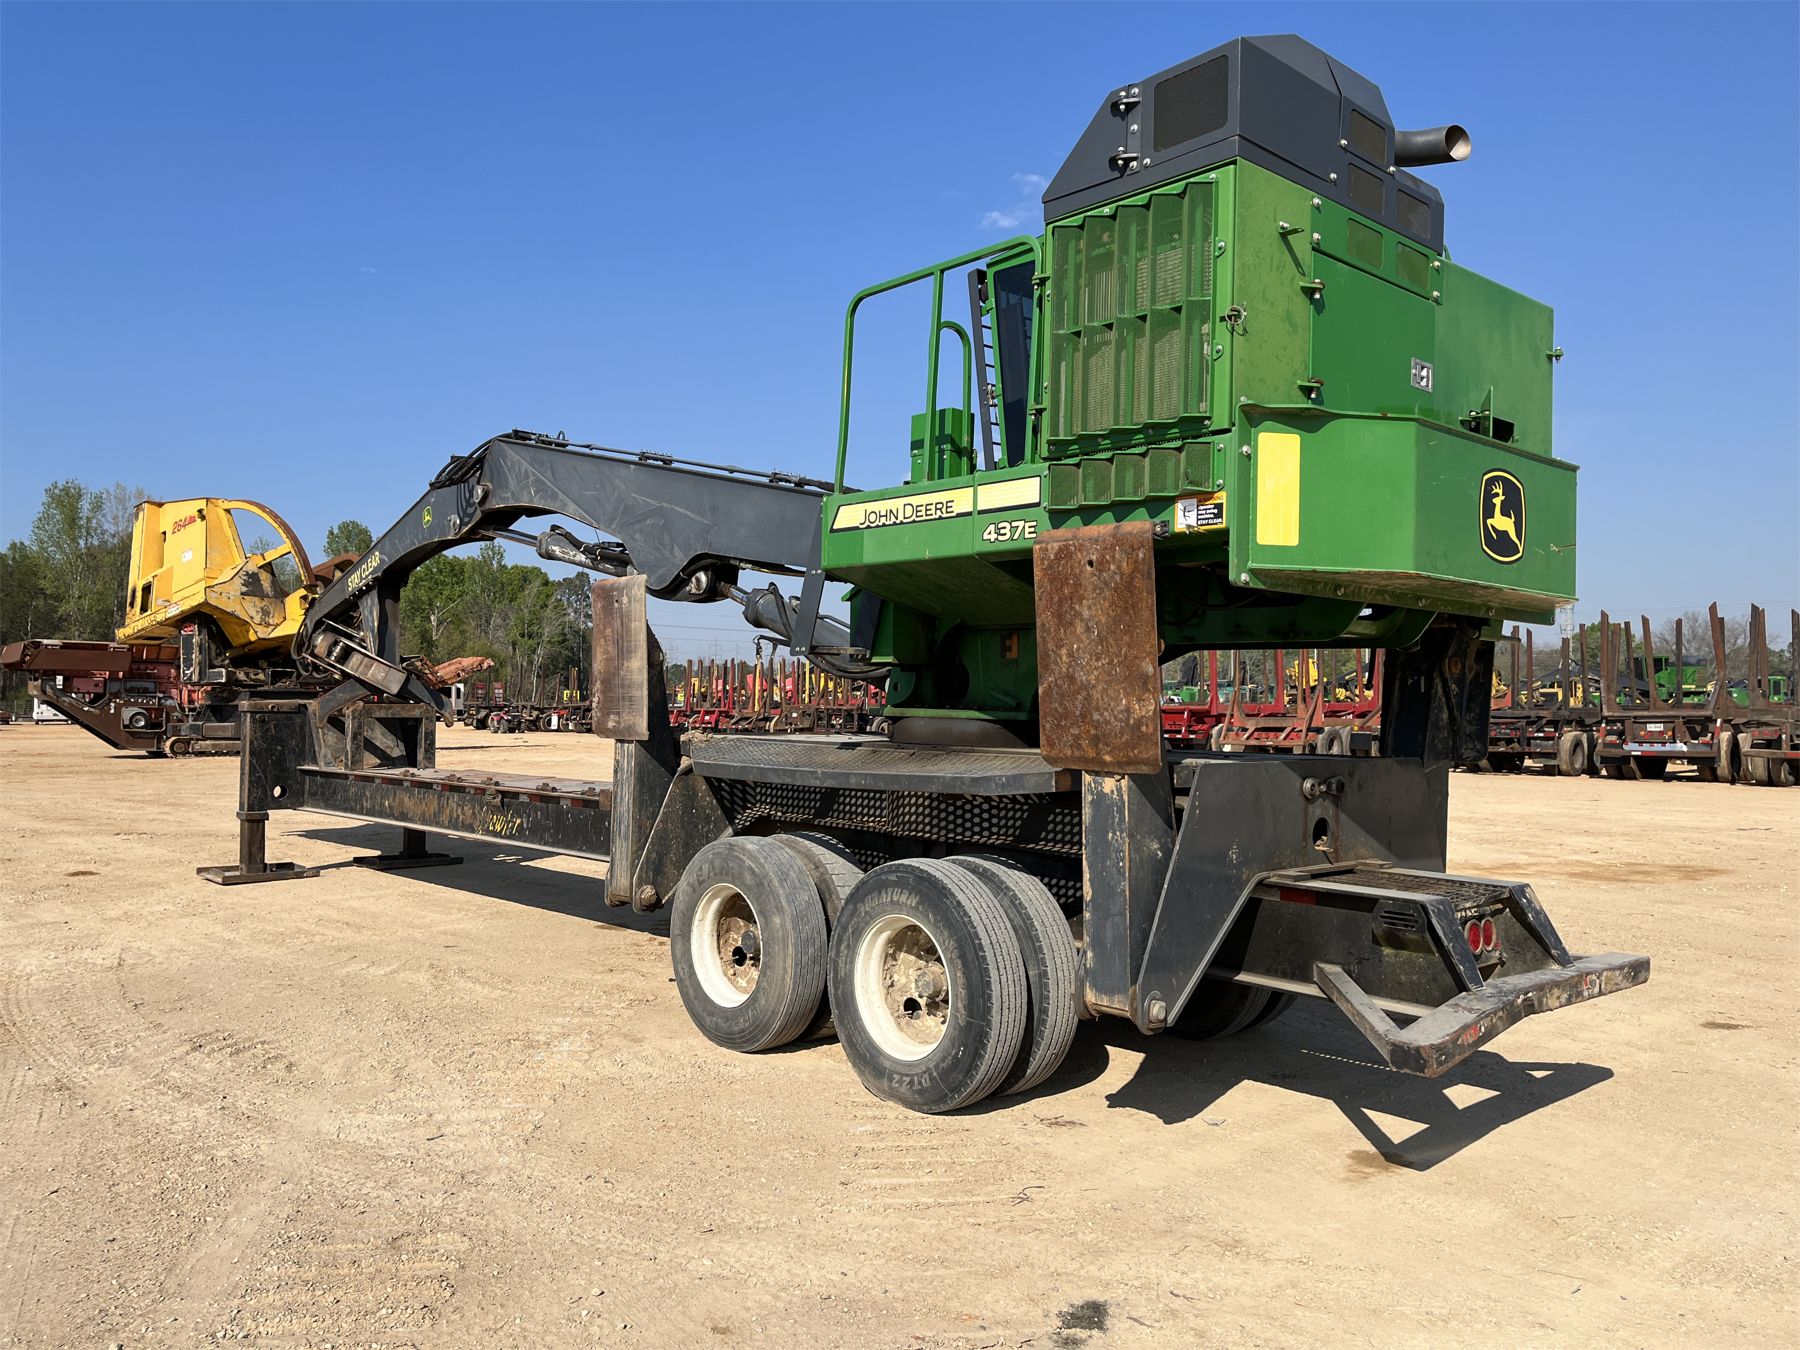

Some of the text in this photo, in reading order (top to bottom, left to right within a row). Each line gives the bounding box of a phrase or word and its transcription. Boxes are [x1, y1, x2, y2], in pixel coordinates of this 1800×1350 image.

[859, 500, 955, 526] JOHN DEERE
[172, 517, 187, 535] 264
[982, 520, 1038, 543] 437E
[347, 551, 381, 591] STAY CLEAR
